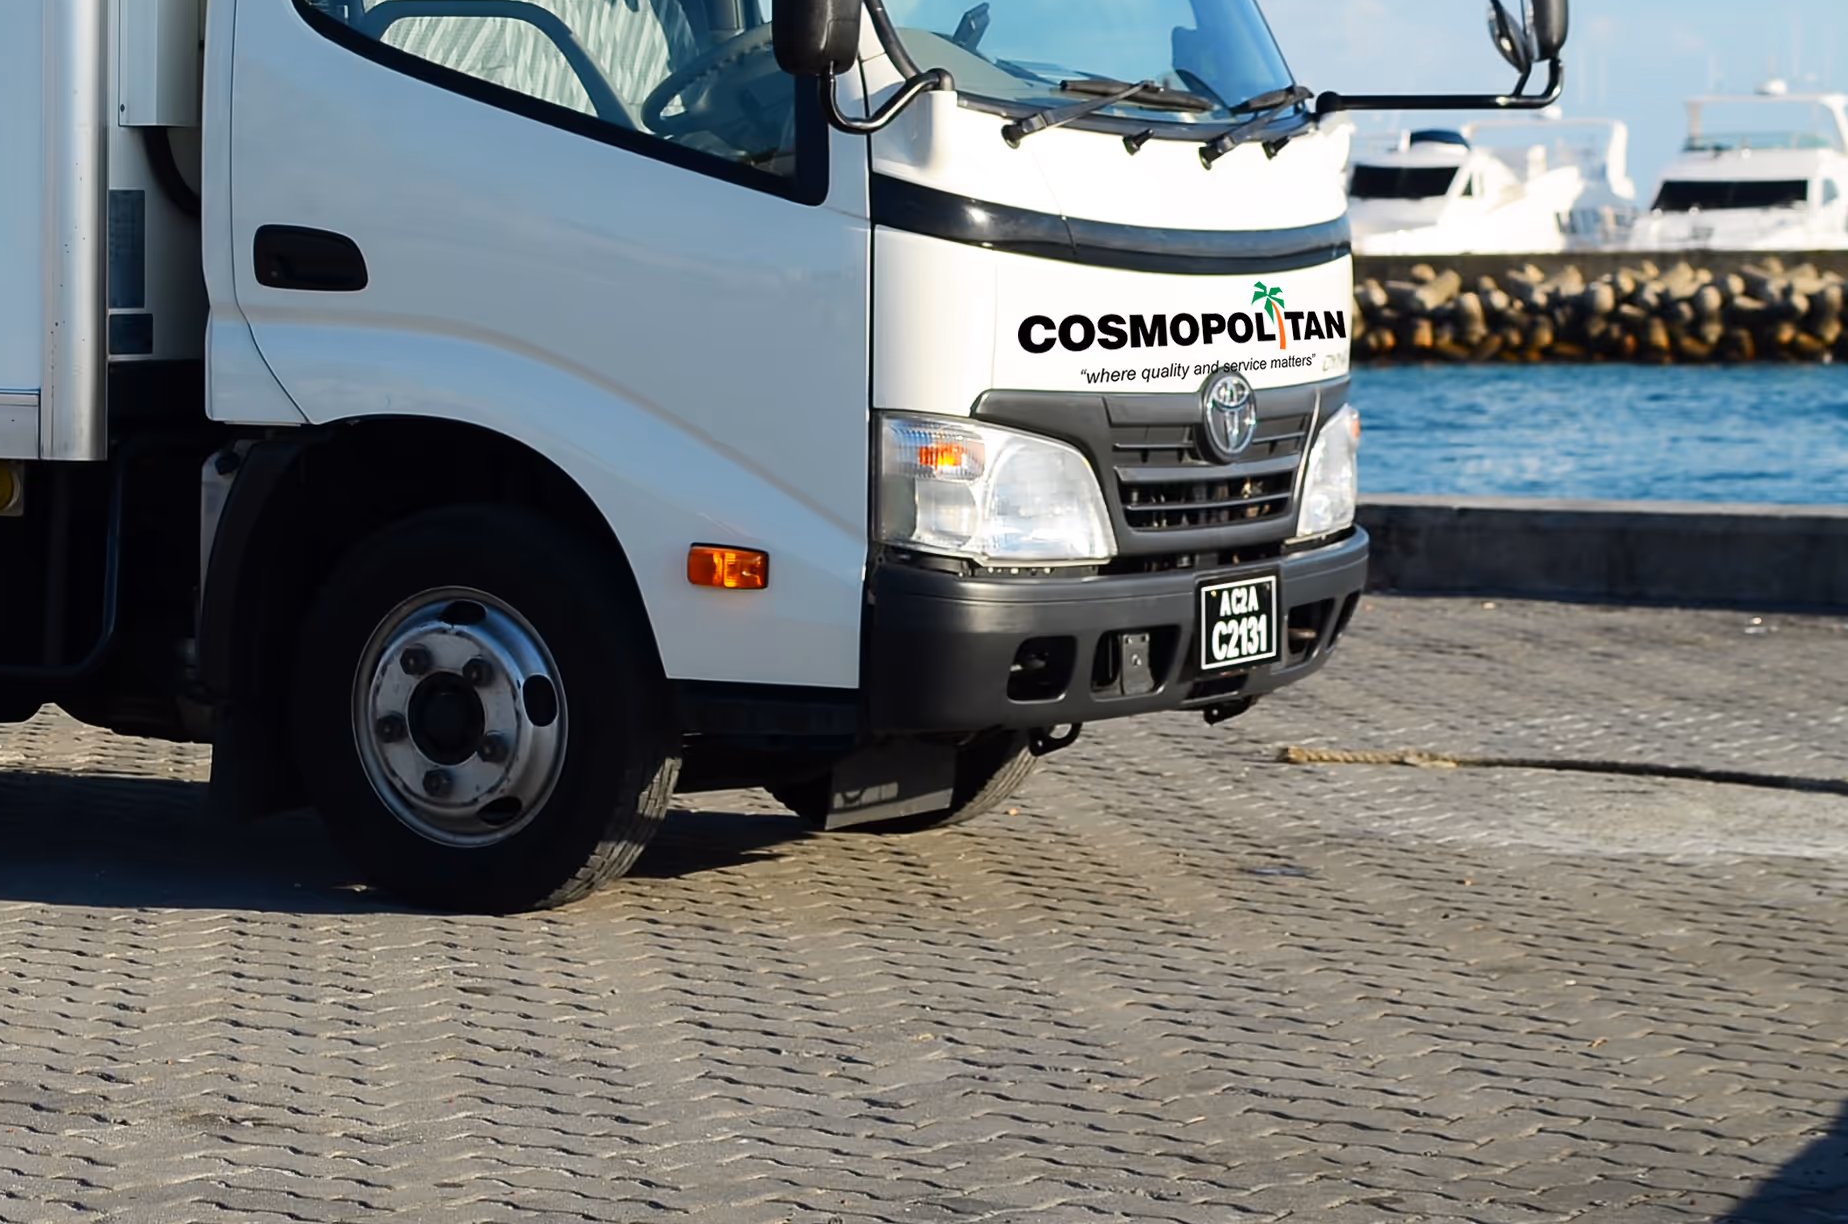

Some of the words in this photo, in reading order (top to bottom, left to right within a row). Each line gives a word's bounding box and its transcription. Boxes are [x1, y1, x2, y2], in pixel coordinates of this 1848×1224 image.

[1017, 296, 1347, 354] COSMOPOLITAN
[1080, 368, 1137, 384] “where
[1141, 363, 1190, 383] quality
[1193, 360, 1220, 377] and
[1223, 359, 1267, 373] service
[1270, 354, 1317, 369] matters”
[1211, 613, 1267, 661] C2131
